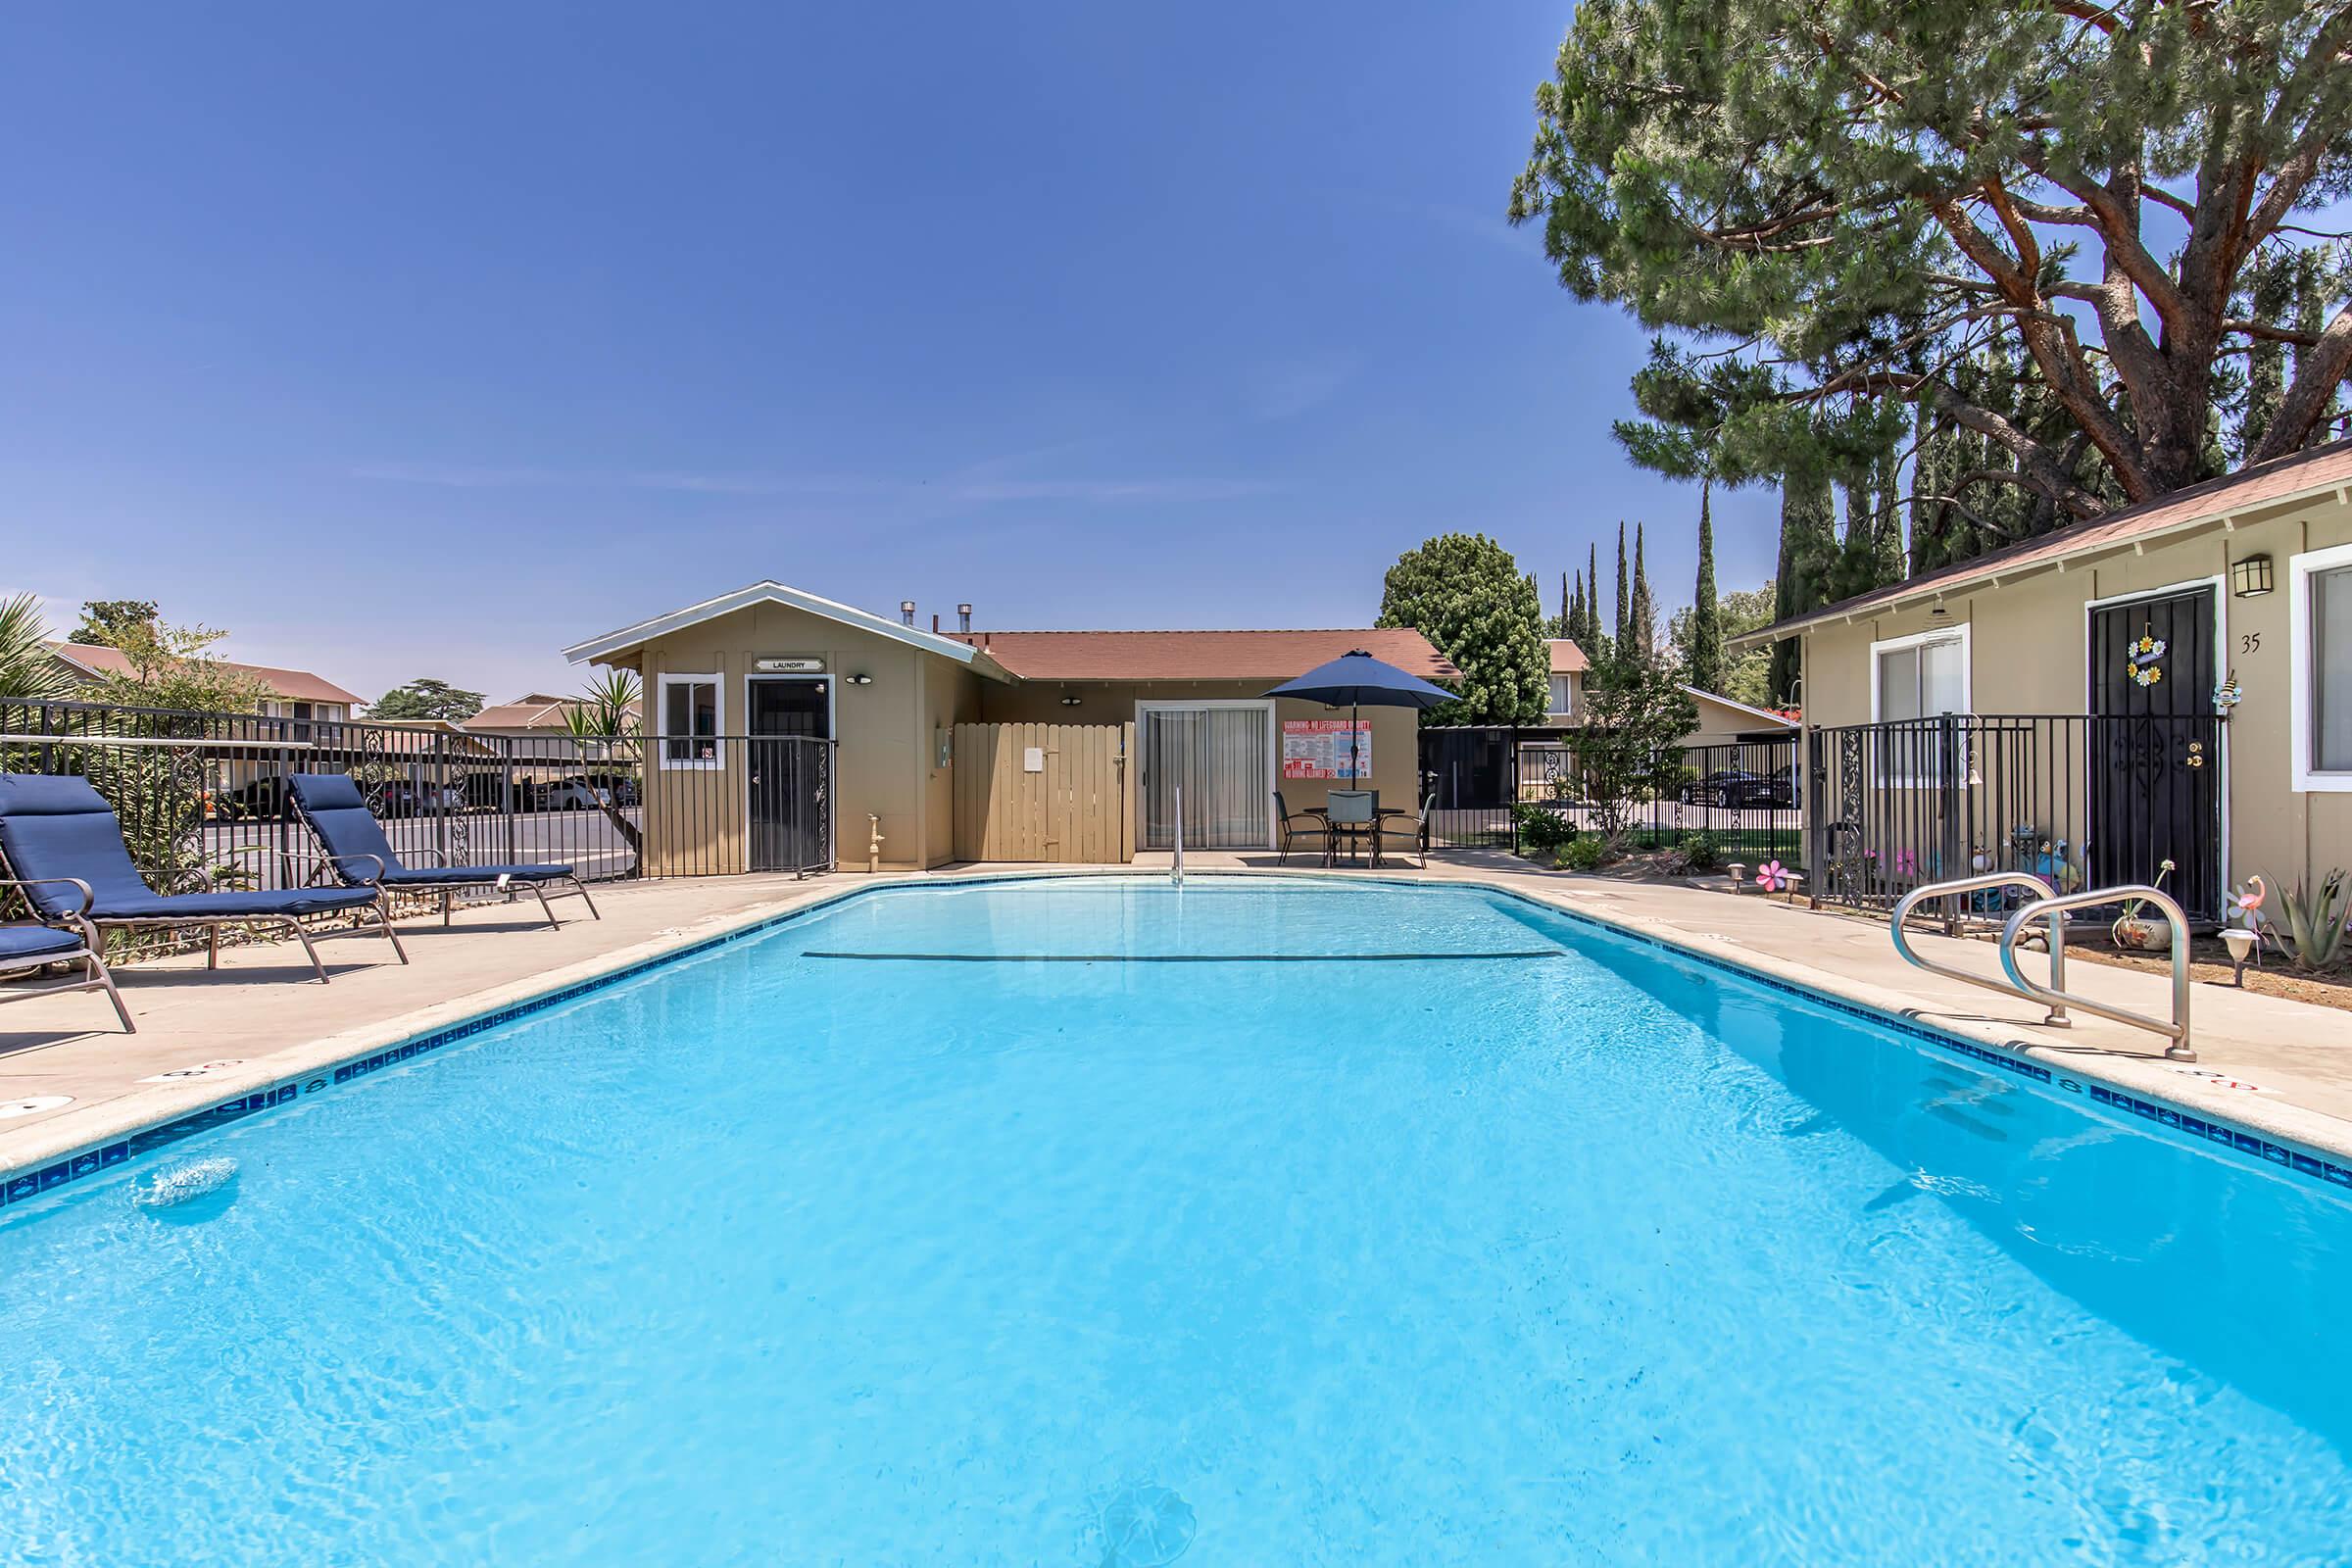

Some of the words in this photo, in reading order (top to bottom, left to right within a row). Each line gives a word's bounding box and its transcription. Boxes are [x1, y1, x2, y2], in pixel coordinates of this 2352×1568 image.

[2241, 632, 2261, 654] 35
[1311, 721, 1318, 730] NO
[1320, 721, 1347, 730] LIFEGUARD
